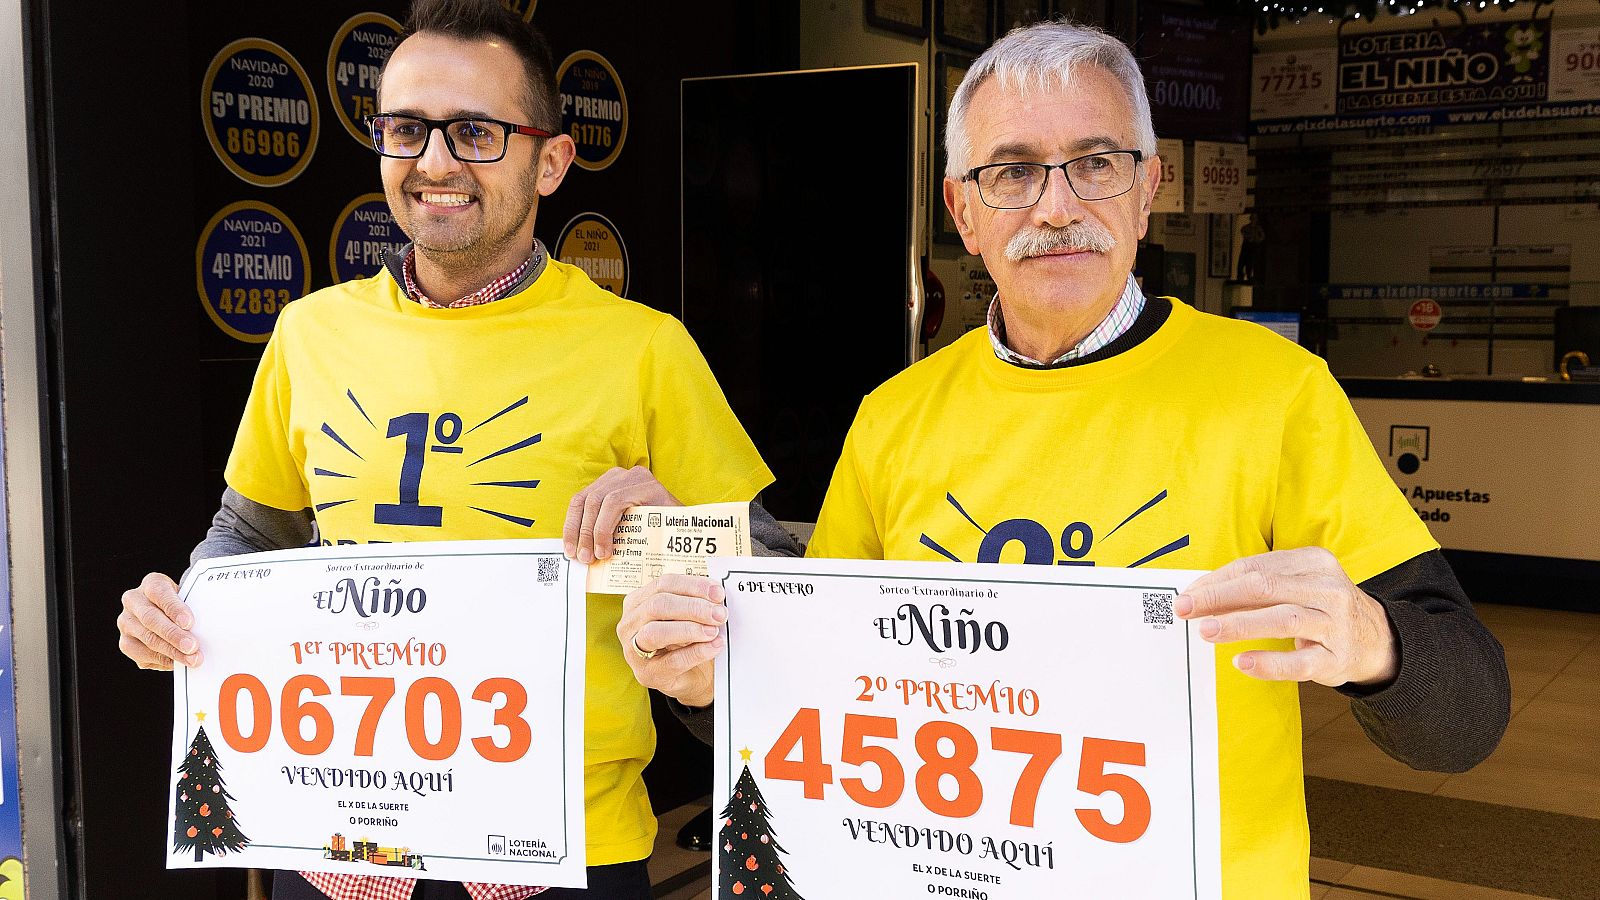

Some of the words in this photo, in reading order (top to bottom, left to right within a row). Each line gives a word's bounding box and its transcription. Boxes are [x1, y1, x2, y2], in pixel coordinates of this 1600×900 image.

[352, 30, 398, 47] NAVIDA
[1342, 31, 1445, 56] LOTERIA
[230, 57, 288, 75] NAVIDAD
[572, 66, 582, 77] EL
[1339, 60, 1389, 92] EL
[1393, 48, 1500, 89] NIÑO
[247, 74, 275, 89] 2020
[1260, 72, 1322, 91] 77715
[211, 90, 234, 118] 5º
[237, 93, 309, 126] PREMIO
[575, 94, 621, 122] PREMIO
[1256, 113, 1431, 135] www.elxdelasuerte.com
[226, 127, 300, 158] 86986
[570, 122, 612, 148] 61776
[1203, 166, 1239, 185] 90693
[354, 210, 396, 223] NAVIDA
[223, 219, 282, 234] NAVIDAD
[368, 225, 390, 236] 2021
[575, 229, 585, 239] EL
[586, 228, 608, 240] NIÑO
[241, 235, 266, 247] 2021
[584, 241, 600, 251] 2021
[344, 240, 361, 264] 4º
[212, 252, 231, 279] 4º
[234, 253, 292, 280] PREMIO
[219, 288, 291, 314] 42833
[374, 412, 463, 527] 1º
[1412, 486, 1490, 503] Apuestas
[665, 514, 689, 527] Lotería
[691, 515, 733, 528] Nacional
[667, 536, 717, 554] 45875
[326, 564, 352, 572] Sorteo
[414, 561, 425, 570] de
[312, 590, 334, 610] El
[331, 576, 427, 618] Niño
[738, 580, 744, 592] 6
[746, 581, 766, 593] DE
[768, 581, 814, 597] ENERO
[879, 584, 910, 595] Sorteo
[912, 585, 984, 600] Extraordinario
[987, 588, 999, 599] de
[873, 617, 897, 640] El
[897, 603, 1009, 654] Niño
[290, 641, 322, 665] 1er
[328, 637, 447, 670] PREMIO
[855, 675, 888, 702] 2º
[895, 678, 1040, 717] PREMIO
[218, 673, 532, 763] 06703
[281, 766, 388, 790] VENDIDO
[391, 769, 453, 797] AQUÍ
[764, 707, 1152, 844] 45875
[337, 800, 347, 808] EL
[348, 801, 354, 809] X
[355, 801, 366, 809] DE
[367, 802, 377, 810] LA
[379, 802, 409, 811] SUERTE
[349, 816, 356, 825] O
[358, 816, 398, 827] PORRIÑO
[509, 838, 547, 849] LOTERÍA
[509, 848, 557, 858] NACIONAL
[842, 817, 973, 855] VENDIDO
[979, 836, 1054, 871] AQUÍ
[912, 863, 924, 873] EL
[926, 865, 933, 875] X
[934, 866, 948, 877] DE
[949, 868, 962, 879] LA
[964, 870, 1001, 885] SUERTE
[927, 883, 936, 894] O
[938, 885, 988, 900] PORRIÑO
